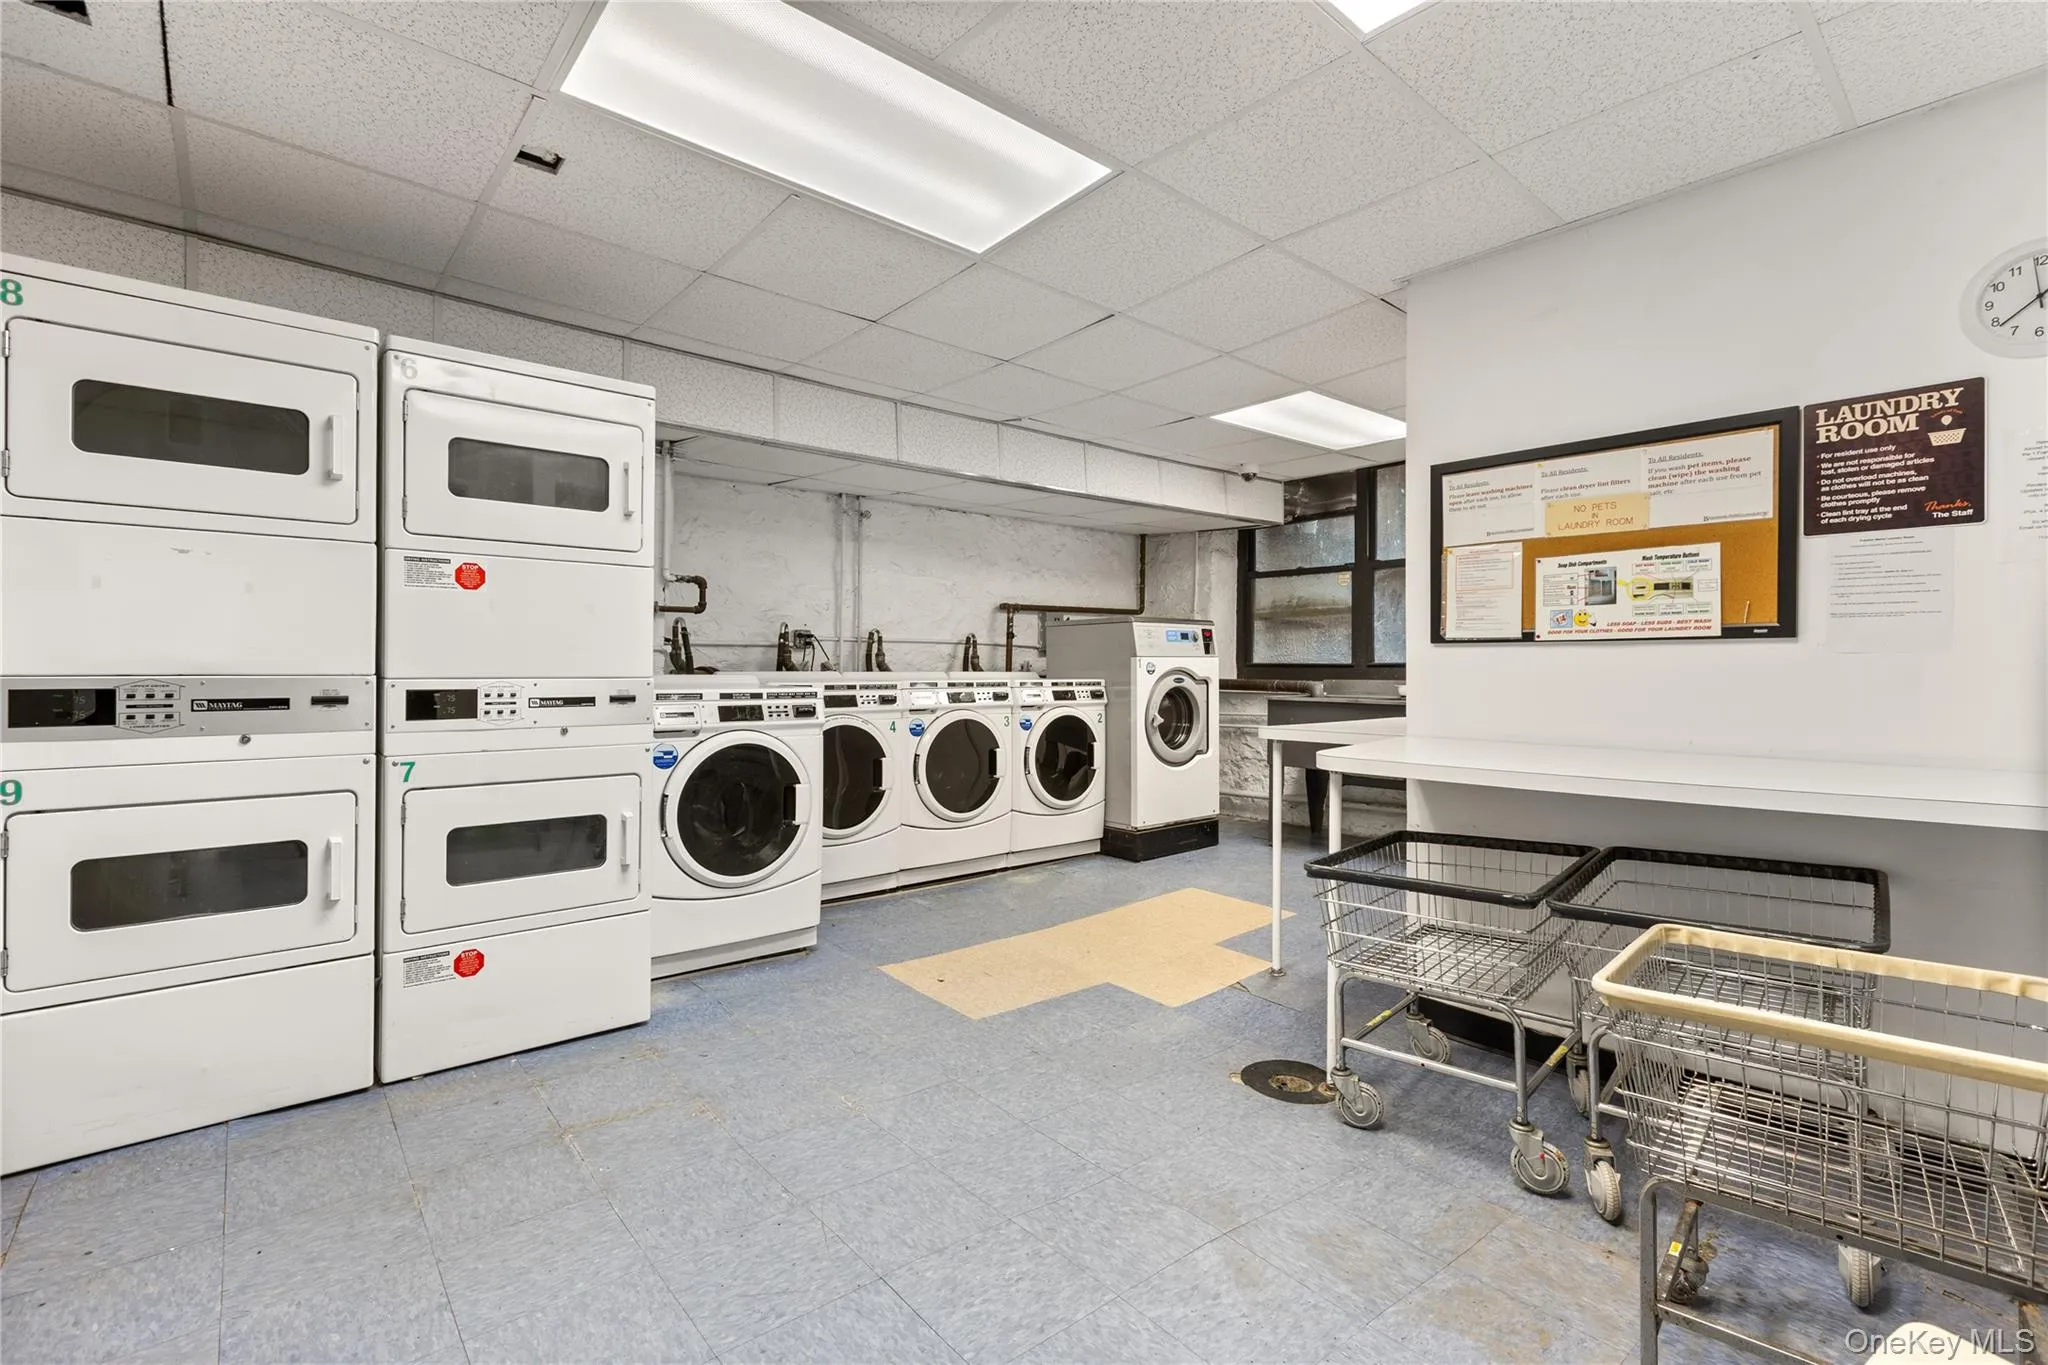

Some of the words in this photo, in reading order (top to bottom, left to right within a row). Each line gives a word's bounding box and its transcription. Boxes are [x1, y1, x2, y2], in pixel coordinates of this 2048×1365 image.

[2008, 266, 2022, 277] 11
[0, 279, 23, 306] 8
[1990, 281, 2006, 293] 10
[1984, 301, 1994, 311] 9
[1991, 317, 2000, 328] 8
[2010, 326, 2019, 336] 7
[2035, 327, 2044, 337] 6
[400, 358, 418, 380] 6
[1816, 387, 1964, 426] LAUNDRY
[1816, 413, 1920, 444] ROOM
[1834, 449, 1863, 457] resident
[1726, 456, 1752, 465] please
[1860, 454, 1903, 464] responsible
[1870, 460, 1905, 469] damaged
[1648, 474, 1667, 482] clean
[1668, 471, 1693, 480] (wipe)
[1708, 466, 1740, 474] washing
[1845, 474, 1877, 482] overload
[1878, 471, 1917, 479] machines,
[1648, 481, 1679, 489] machine
[1749, 471, 1762, 479] pet
[1481, 488, 1504, 496] washing
[1505, 484, 1533, 492] machines
[1897, 486, 1926, 494] remove
[1848, 497, 1880, 506] promptly
[1573, 504, 1587, 513] NO
[1591, 502, 1617, 511] PETS
[1848, 515, 1872, 523] drying
[1932, 511, 1950, 519] The
[1951, 509, 1974, 518] Staff
[1558, 520, 1600, 531] LAUNDRY
[1606, 516, 1634, 526] ROOM
[209, 702, 243, 710] MAYTAG
[1004, 716, 1010, 727] 3
[1097, 713, 1103, 723] 2
[889, 721, 896, 733] 4
[400, 762, 416, 783] 7
[0, 779, 23, 806] 9
